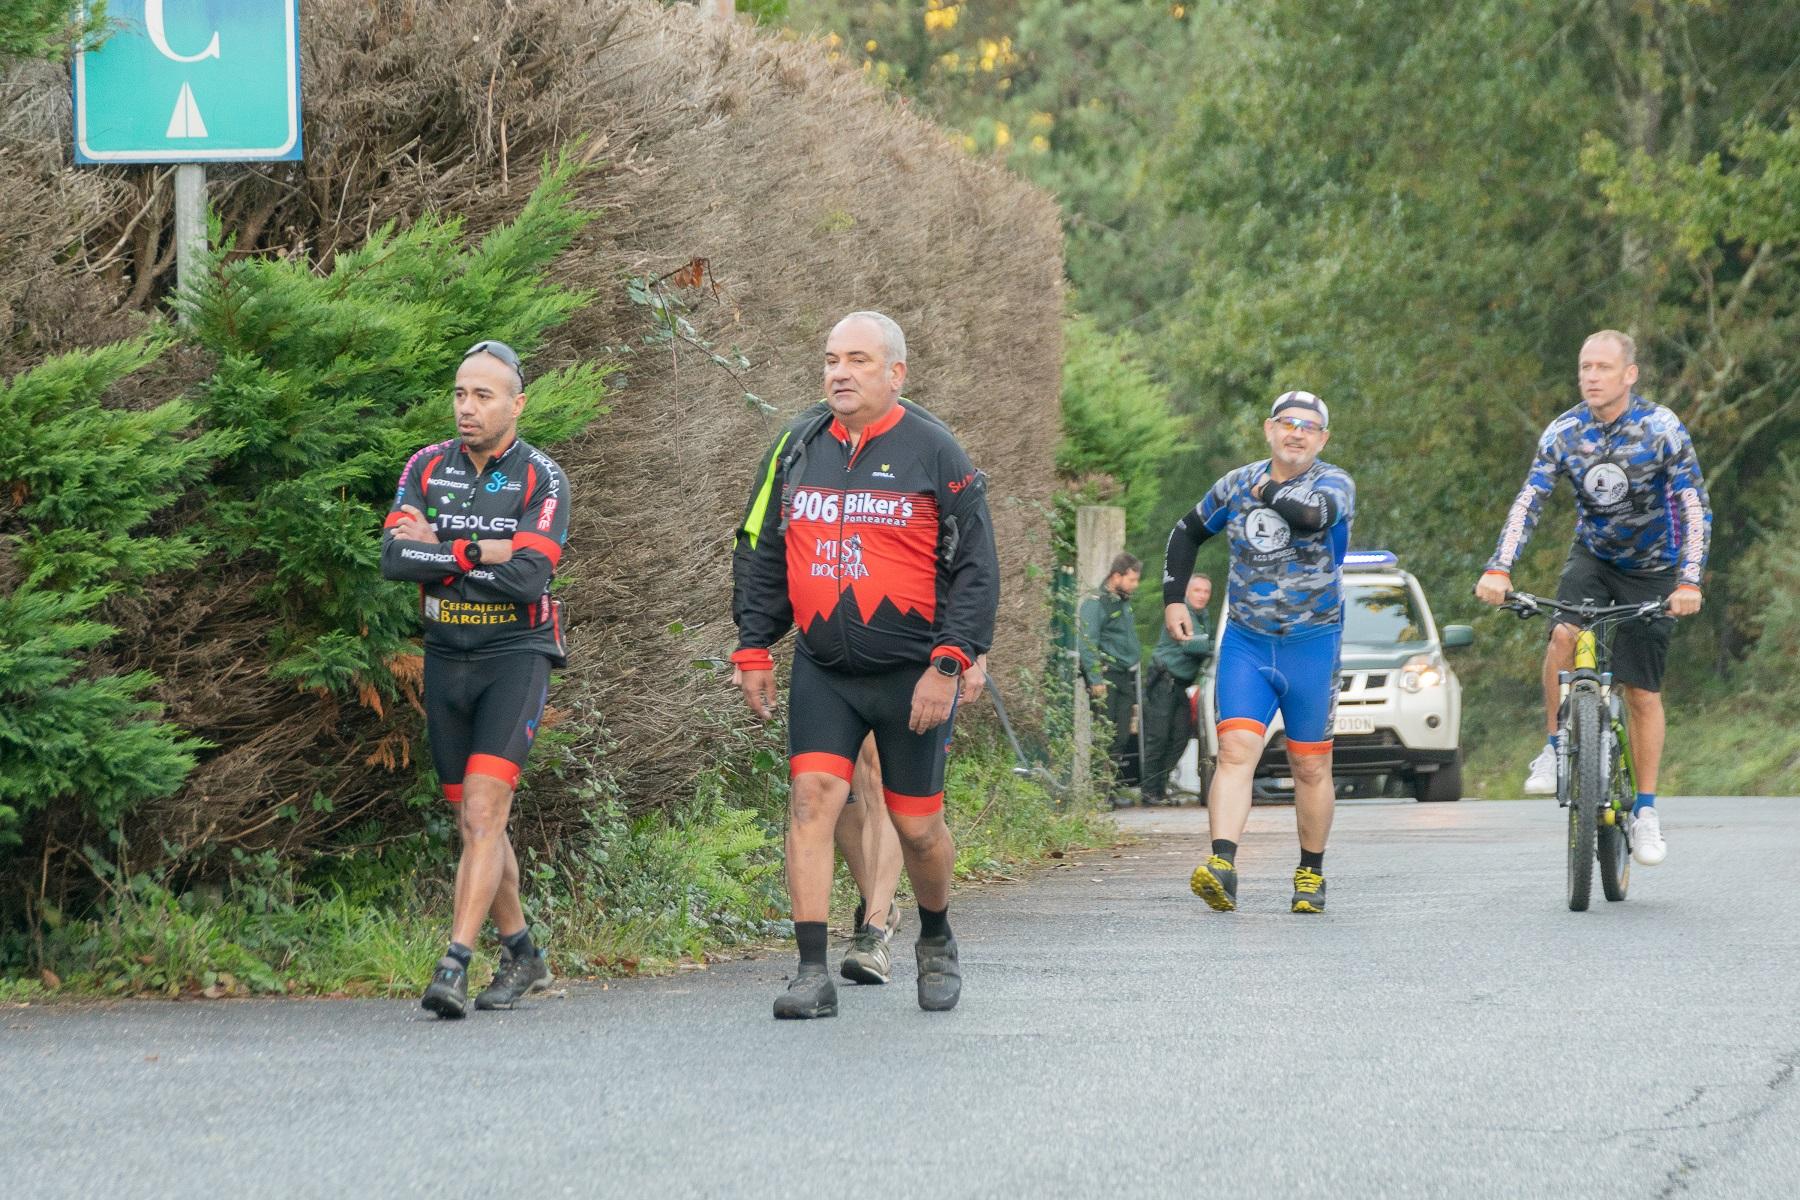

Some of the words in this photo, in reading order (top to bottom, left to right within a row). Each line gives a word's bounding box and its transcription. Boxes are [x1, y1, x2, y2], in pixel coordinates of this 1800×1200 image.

[530, 449, 560, 498] TROLLEY
[538, 499, 558, 530] BIKE
[792, 491, 839, 523] 906
[844, 493, 913, 518] Biker's
[843, 515, 907, 527] Ponteareas
